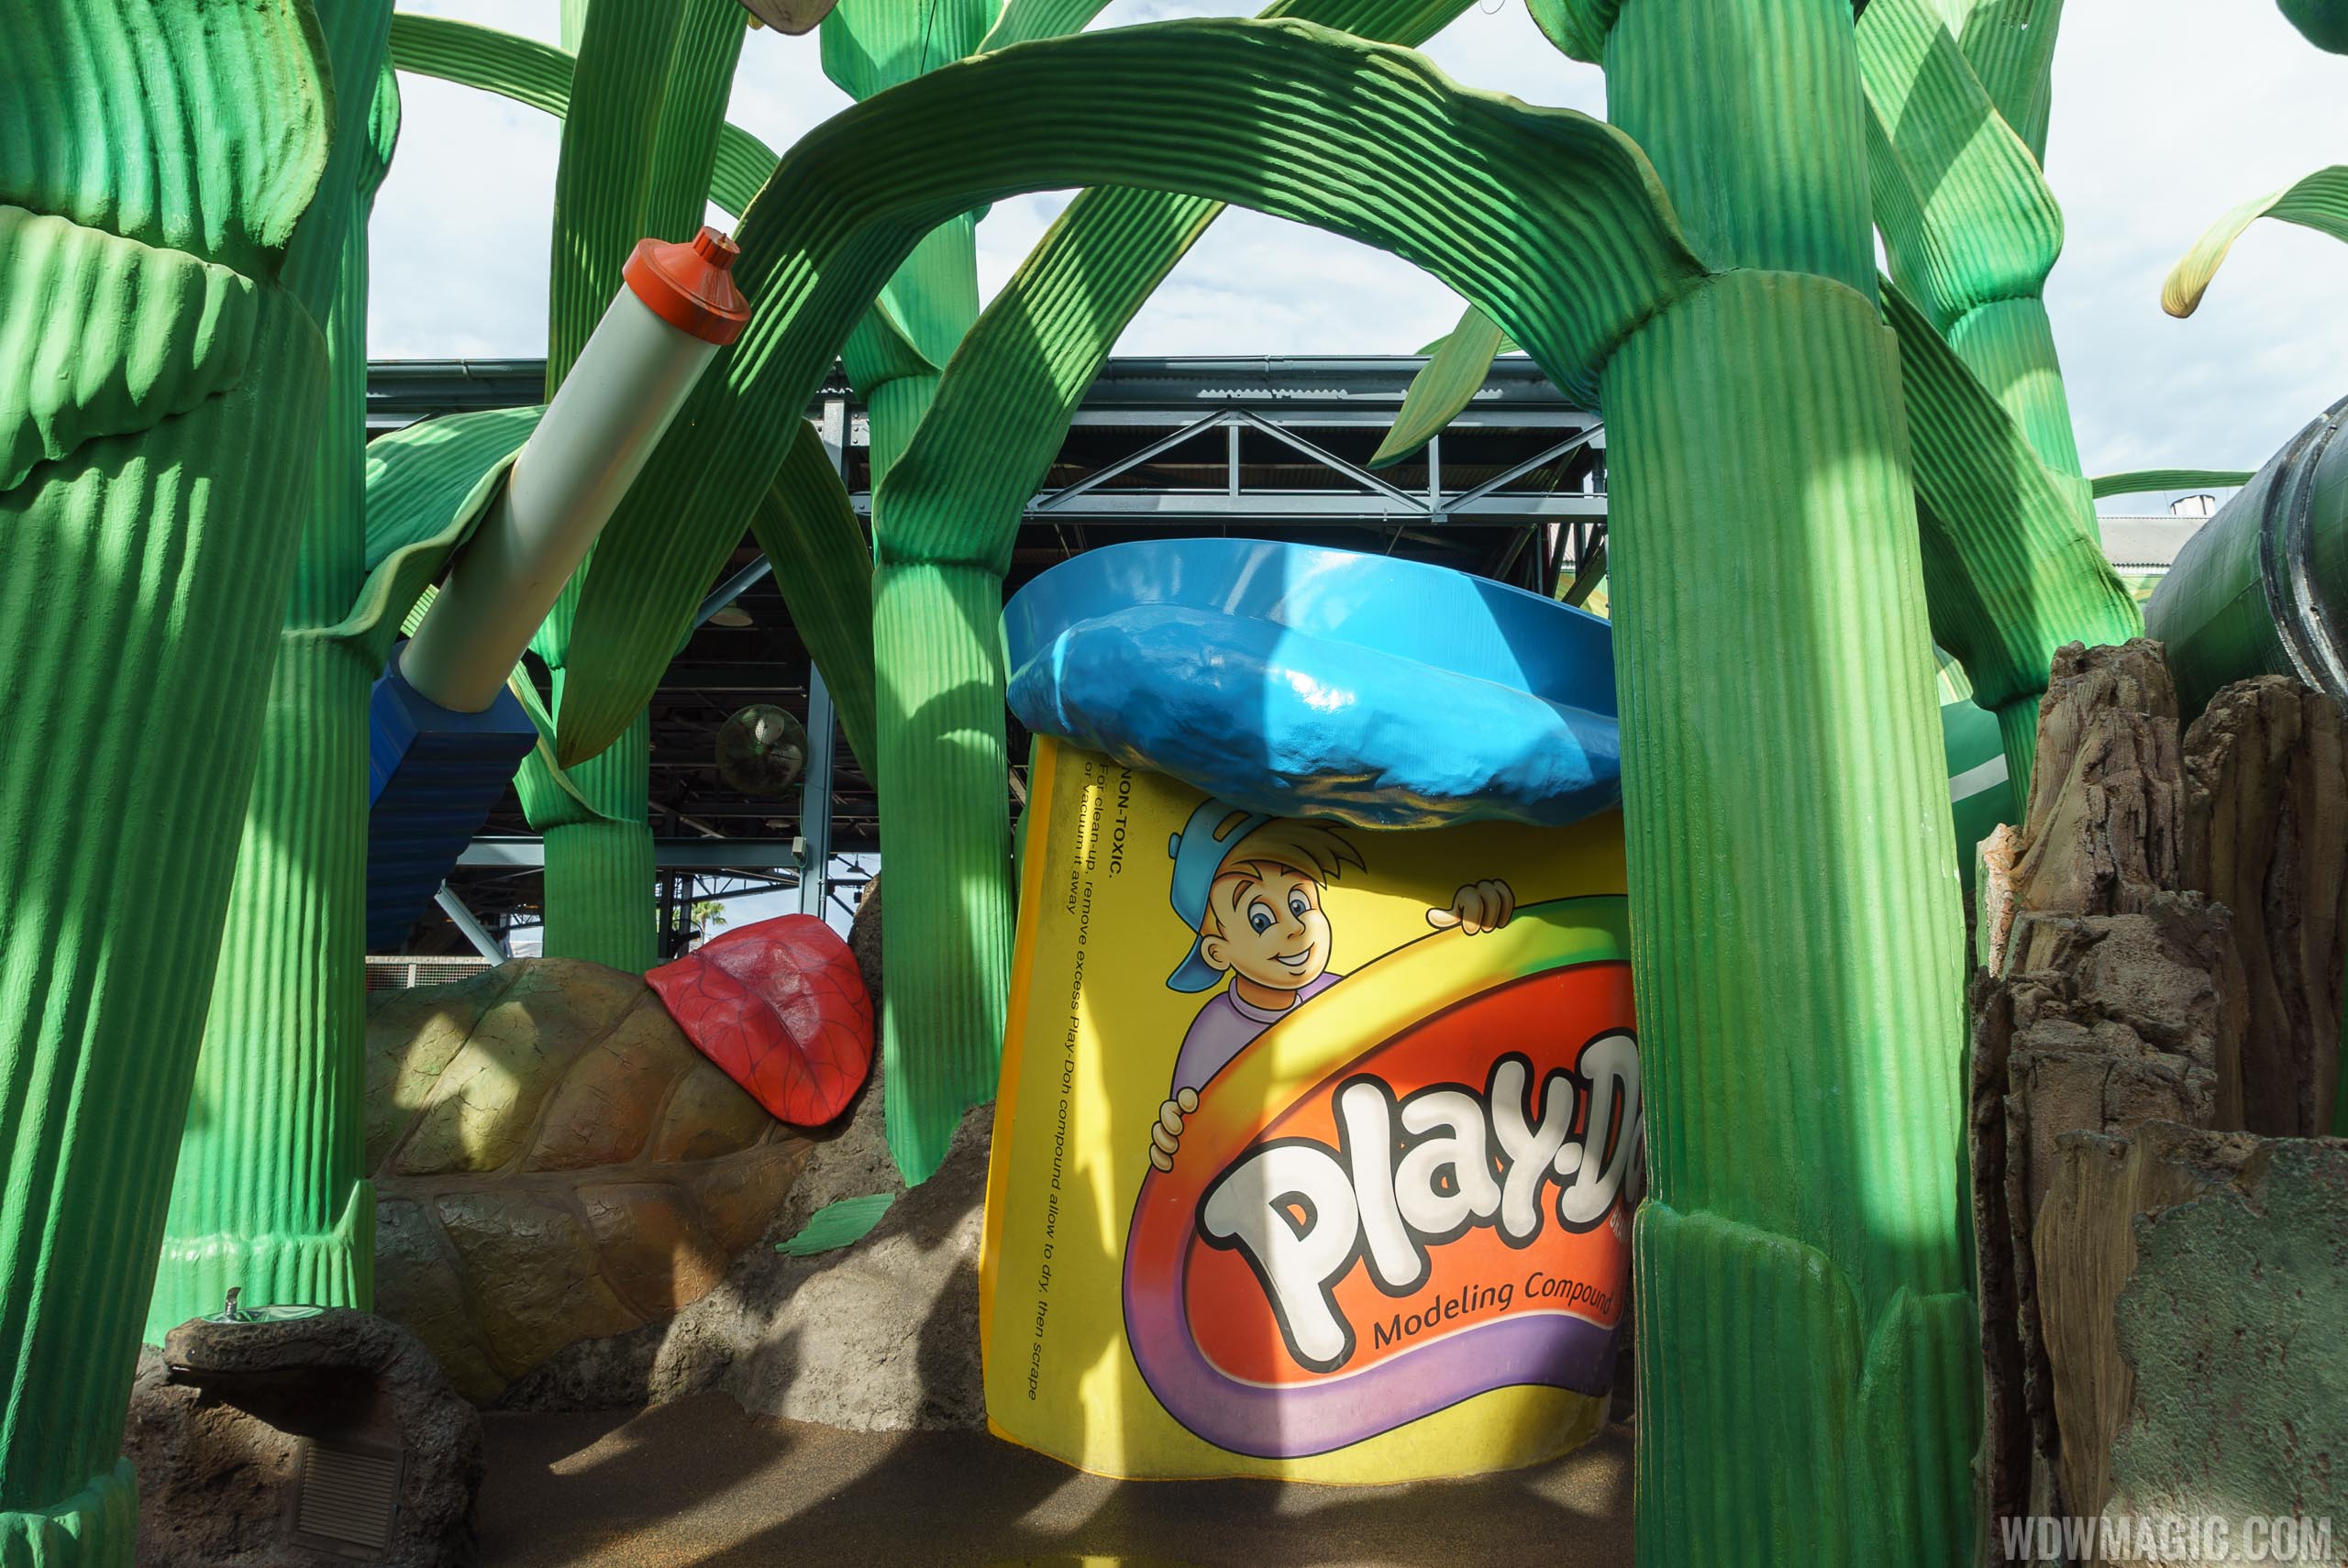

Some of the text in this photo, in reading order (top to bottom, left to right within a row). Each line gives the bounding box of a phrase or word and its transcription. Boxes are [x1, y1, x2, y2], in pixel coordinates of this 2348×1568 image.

[1096, 764, 1109, 792] For
[1066, 762, 1092, 915] or vacuum it away
[1085, 796, 1103, 874] clean-up,
[1109, 767, 1133, 878] NON-TOXIC.
[1079, 881, 1094, 945] remove
[1070, 950, 1085, 1010] excess
[1062, 1015, 1080, 1094] Play-Doh
[1052, 1099, 1069, 1190] compound
[1047, 1194, 1059, 1239] allow
[1044, 1243, 1055, 1259] to
[1035, 1300, 1048, 1338] then
[1373, 1272, 1614, 1350] Modeling Compound
[1027, 1342, 1042, 1401] scrape
